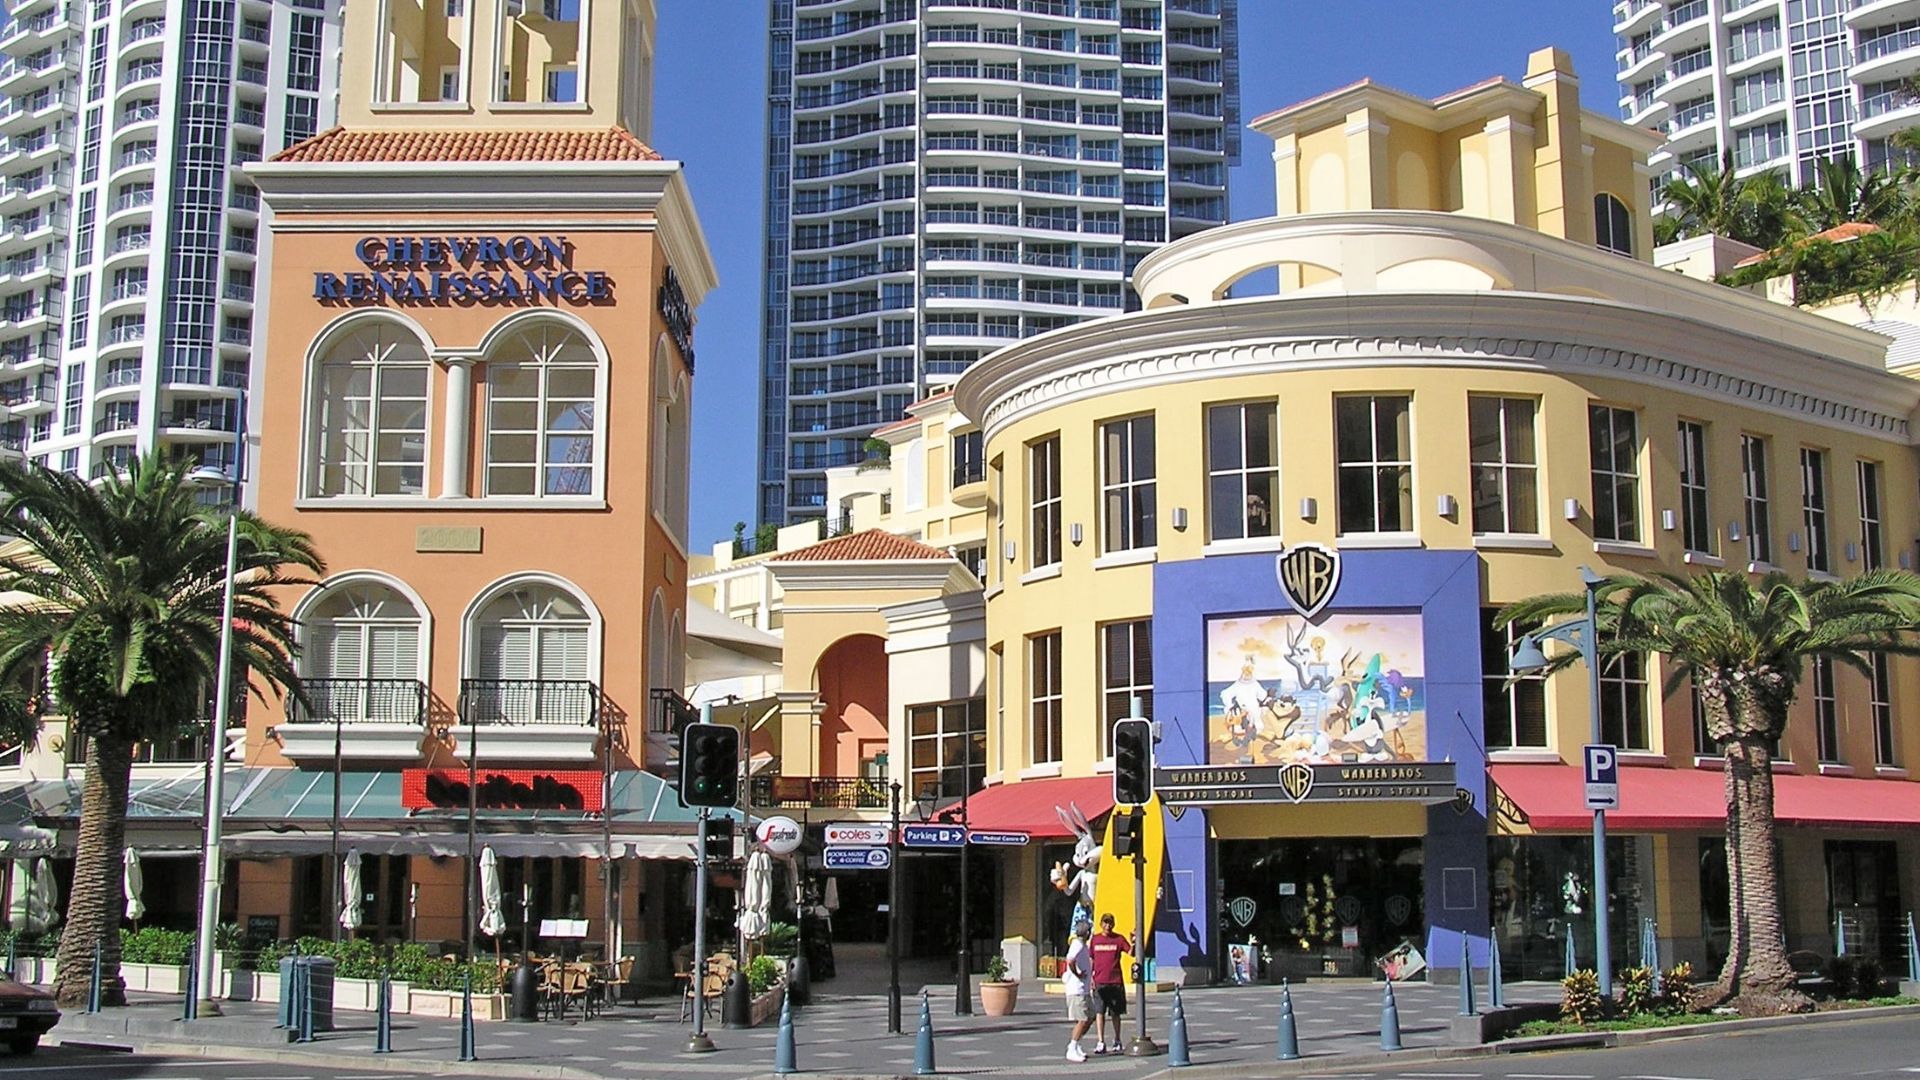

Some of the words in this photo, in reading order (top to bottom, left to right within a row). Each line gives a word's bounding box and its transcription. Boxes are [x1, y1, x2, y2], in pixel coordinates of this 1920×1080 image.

[355, 236, 567, 263] CHEVRON
[313, 271, 606, 298] RENAISSANCE
[1283, 550, 1332, 607] WB
[1590, 749, 1612, 780] P
[1171, 772, 1214, 783] WARNER
[1283, 766, 1310, 798] WB
[1341, 768, 1388, 779] WARNER
[1168, 791, 1208, 800] STUDIO
[1215, 789, 1254, 799] STORE
[1338, 787, 1381, 797] STUDIO
[1389, 786, 1431, 796] STORE
[839, 829, 871, 840] coles
[907, 831, 937, 842] Parking
[1233, 899, 1254, 923] WB
